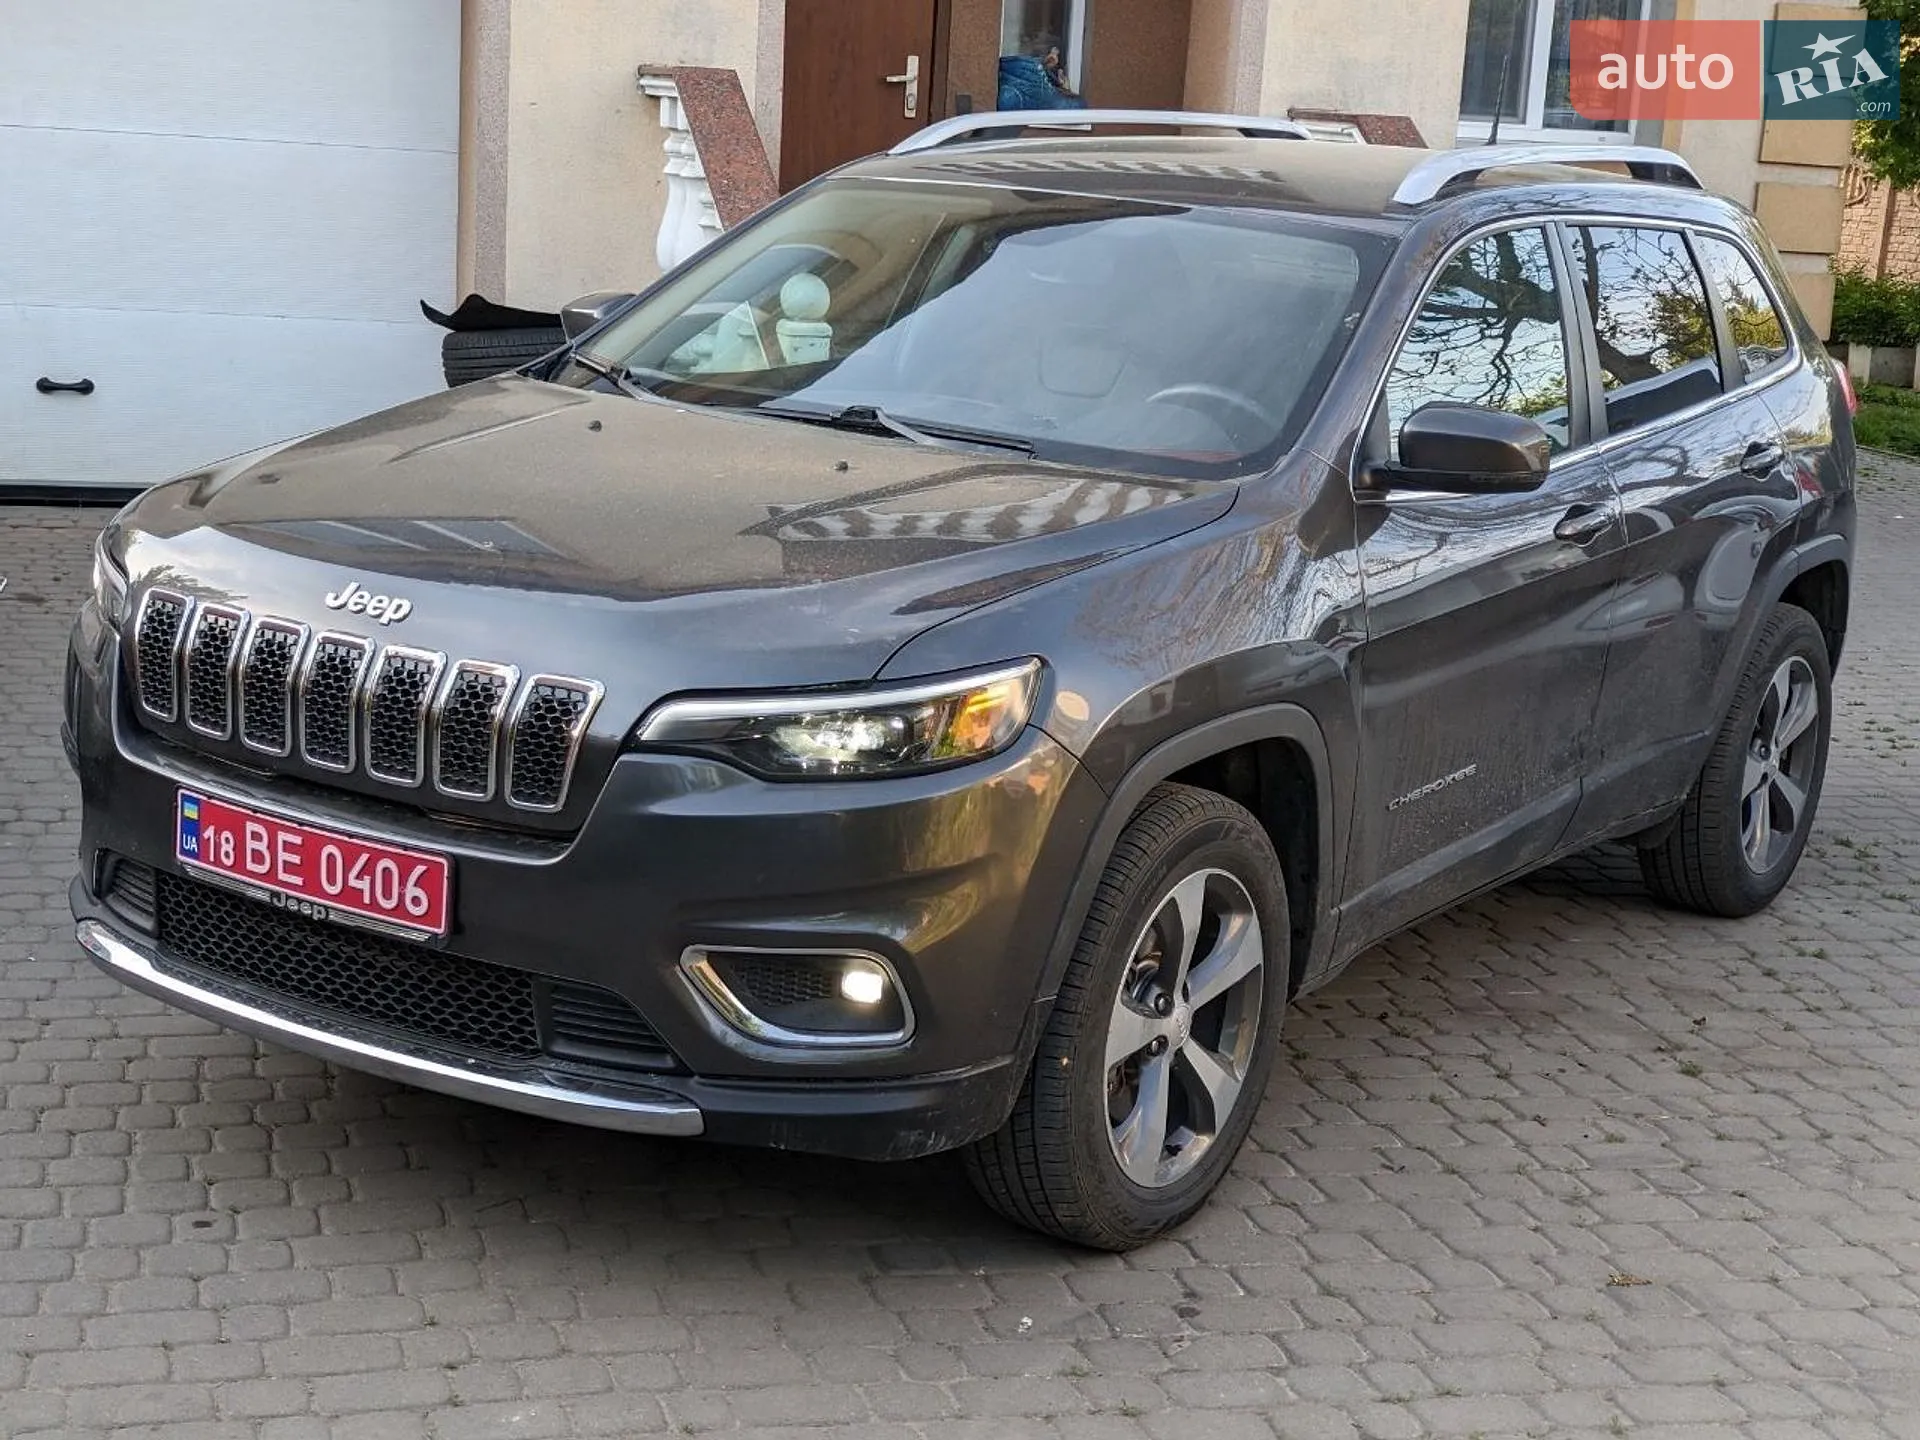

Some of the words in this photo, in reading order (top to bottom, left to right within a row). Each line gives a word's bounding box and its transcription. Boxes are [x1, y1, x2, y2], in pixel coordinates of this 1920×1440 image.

[325, 582, 413, 626] Jeep
[1388, 763, 1477, 811] CHEROKEE
[182, 833, 198, 852] UA
[203, 824, 235, 867] 18
[245, 820, 304, 886] BE
[320, 844, 430, 917] 0406
[272, 892, 327, 920] Jeep
